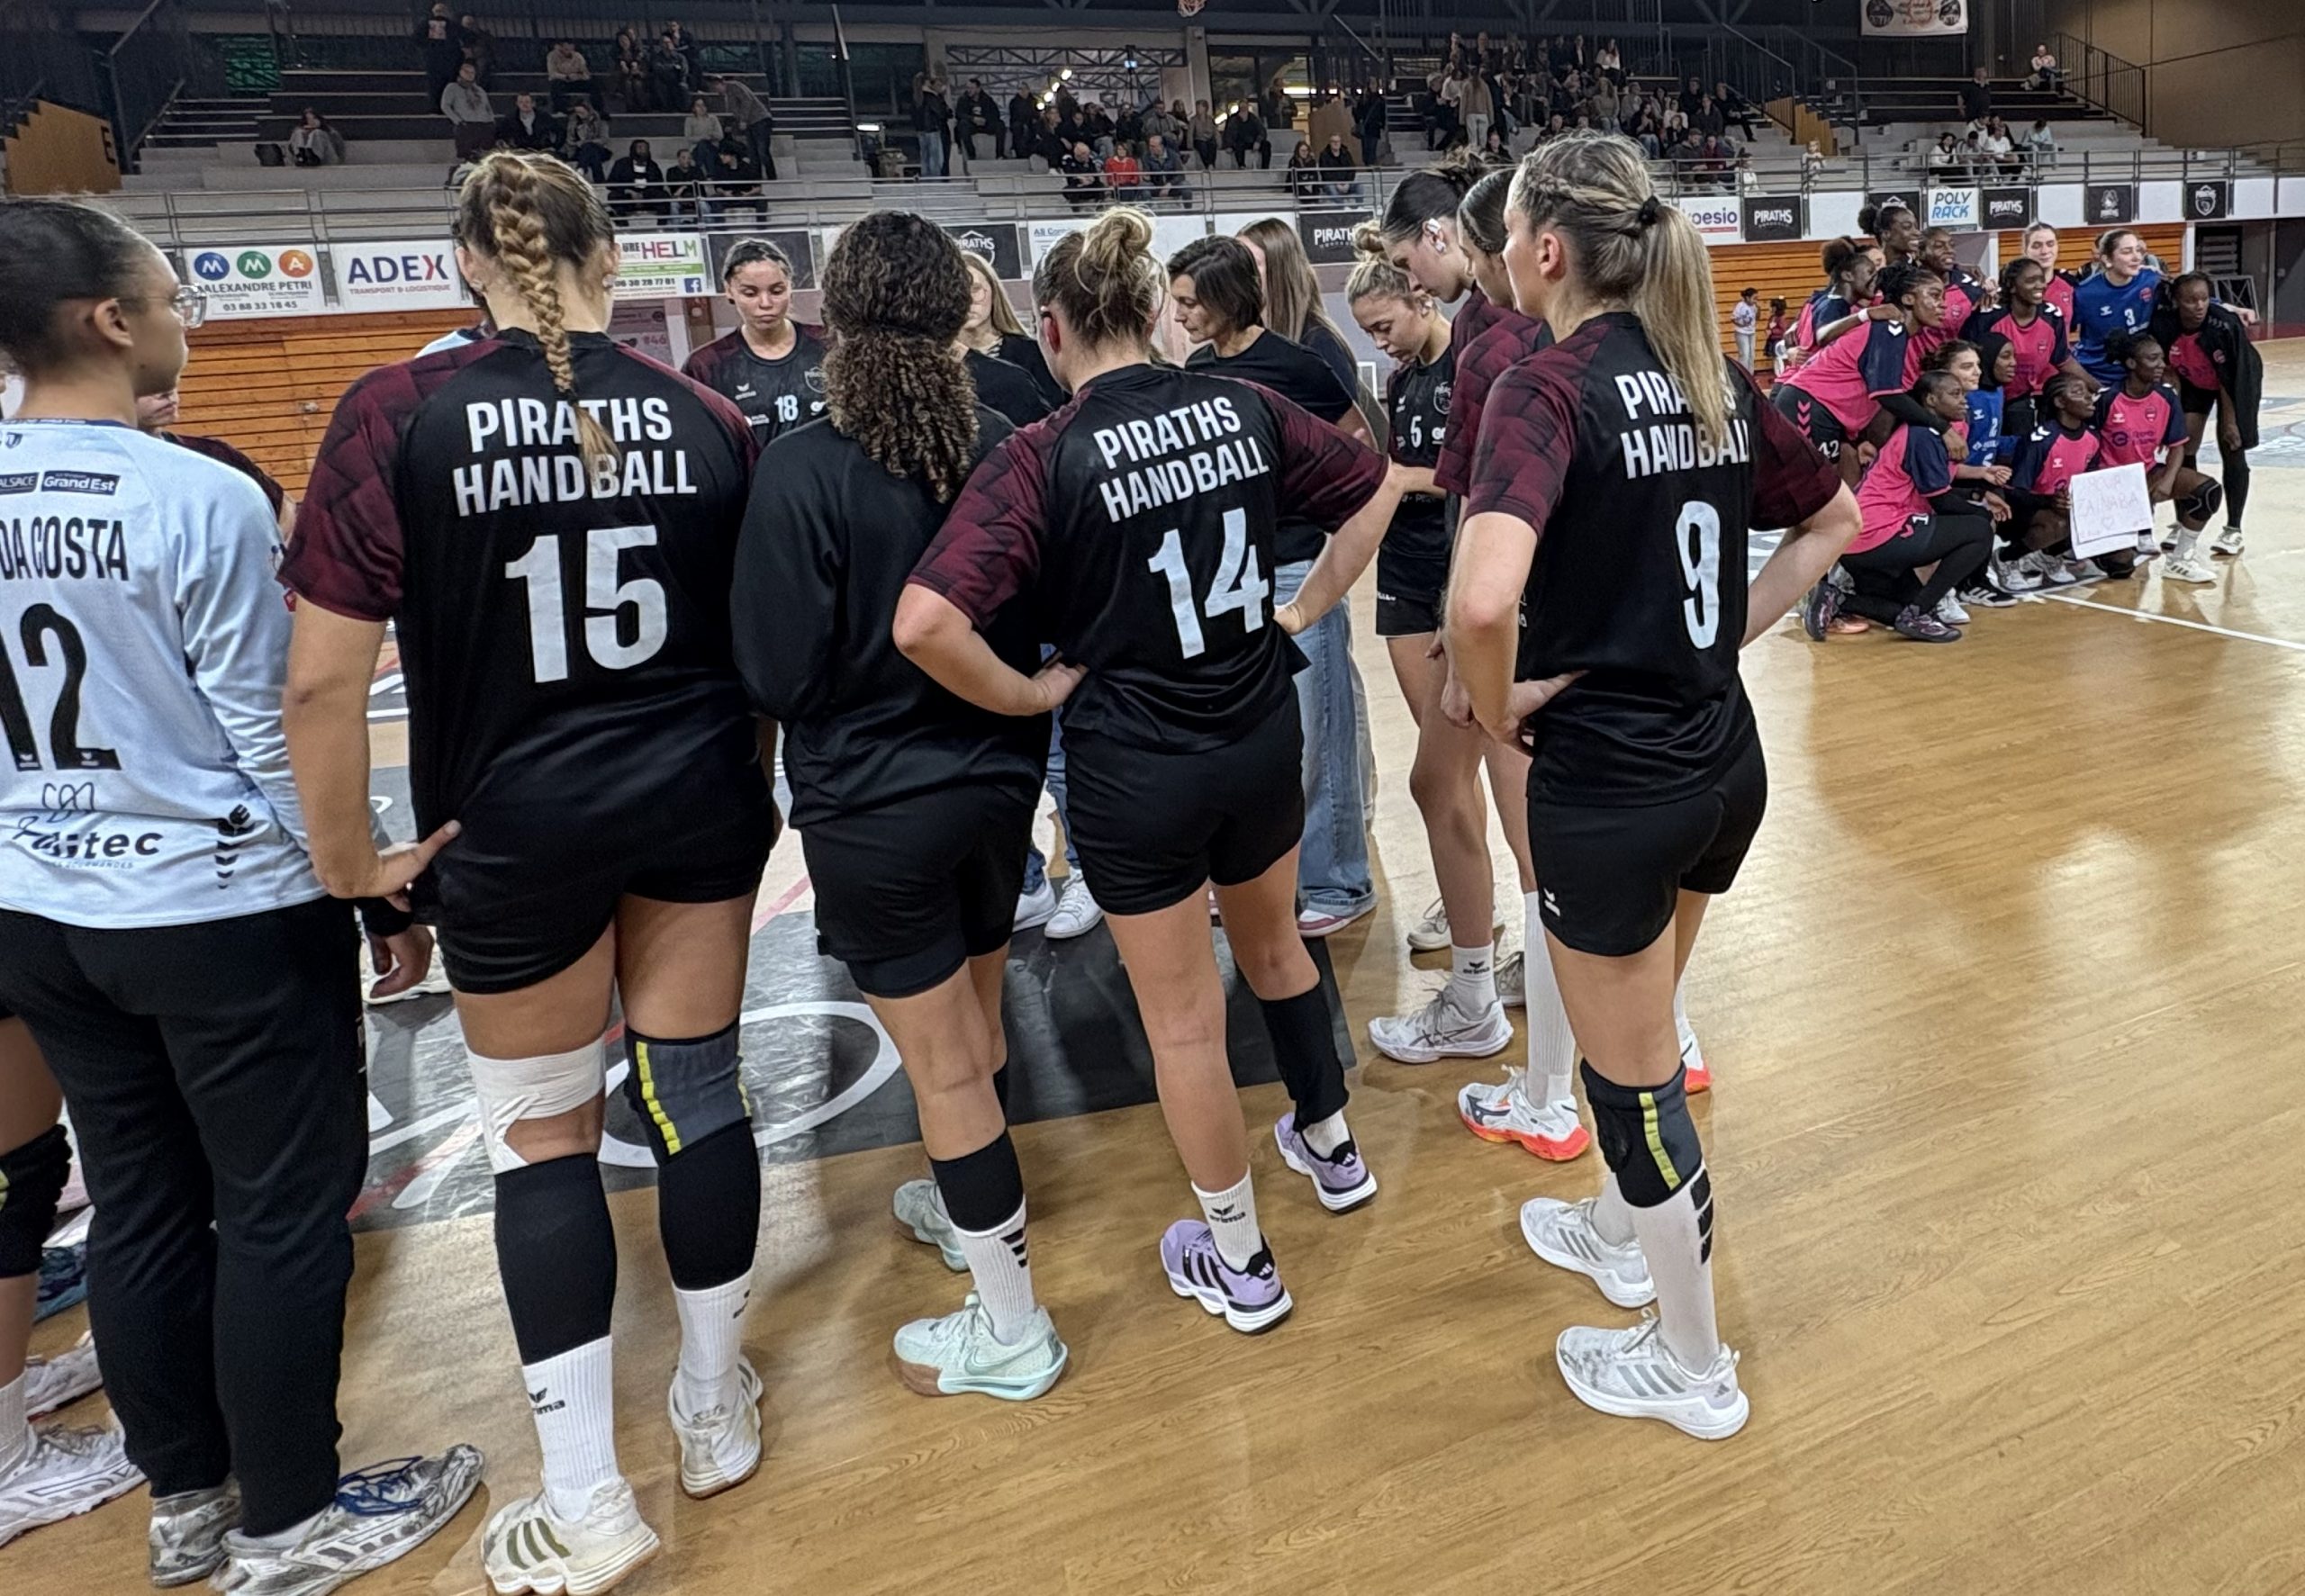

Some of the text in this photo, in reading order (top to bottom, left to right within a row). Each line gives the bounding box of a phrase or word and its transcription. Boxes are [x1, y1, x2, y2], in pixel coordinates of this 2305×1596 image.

[101, 126, 115, 166] E
[1931, 205, 1969, 219] RACK
[1935, 191, 1972, 205] POLY
[1989, 200, 2024, 215] PIRATHS
[1687, 207, 1738, 224] oesio
[1753, 209, 1793, 225] PIRATHS
[640, 240, 698, 259] HELM
[1314, 227, 1356, 246] PIRATH
[348, 254, 448, 284] ADEX
[278, 281, 312, 290] PETRI
[349, 286, 395, 295] TRANSPORT
[405, 284, 451, 293] LOGISTIQUE
[222, 302, 237, 311] 03
[254, 301, 267, 310] 33
[284, 300, 298, 309] 45
[2124, 308, 2136, 327] 3
[774, 394, 799, 423] 18
[1614, 370, 1737, 420] PIRAS
[466, 397, 673, 453] PIRATHS
[1093, 396, 1242, 470] PIRATHS
[1410, 415, 1423, 448] 5
[1988, 418, 1999, 437] 2
[1620, 419, 1749, 480] HANDBALL
[43, 475, 90, 489] Grand
[90, 478, 115, 491] Est
[452, 450, 698, 518] HANDBALL
[1099, 437, 1270, 523] HANDBALL
[0, 516, 129, 582] DA COSTA
[1147, 507, 1270, 660] 14
[1676, 500, 1721, 650] 9
[504, 524, 668, 683] 15
[0, 602, 122, 772] 12
[531, 1400, 566, 1416] rima
